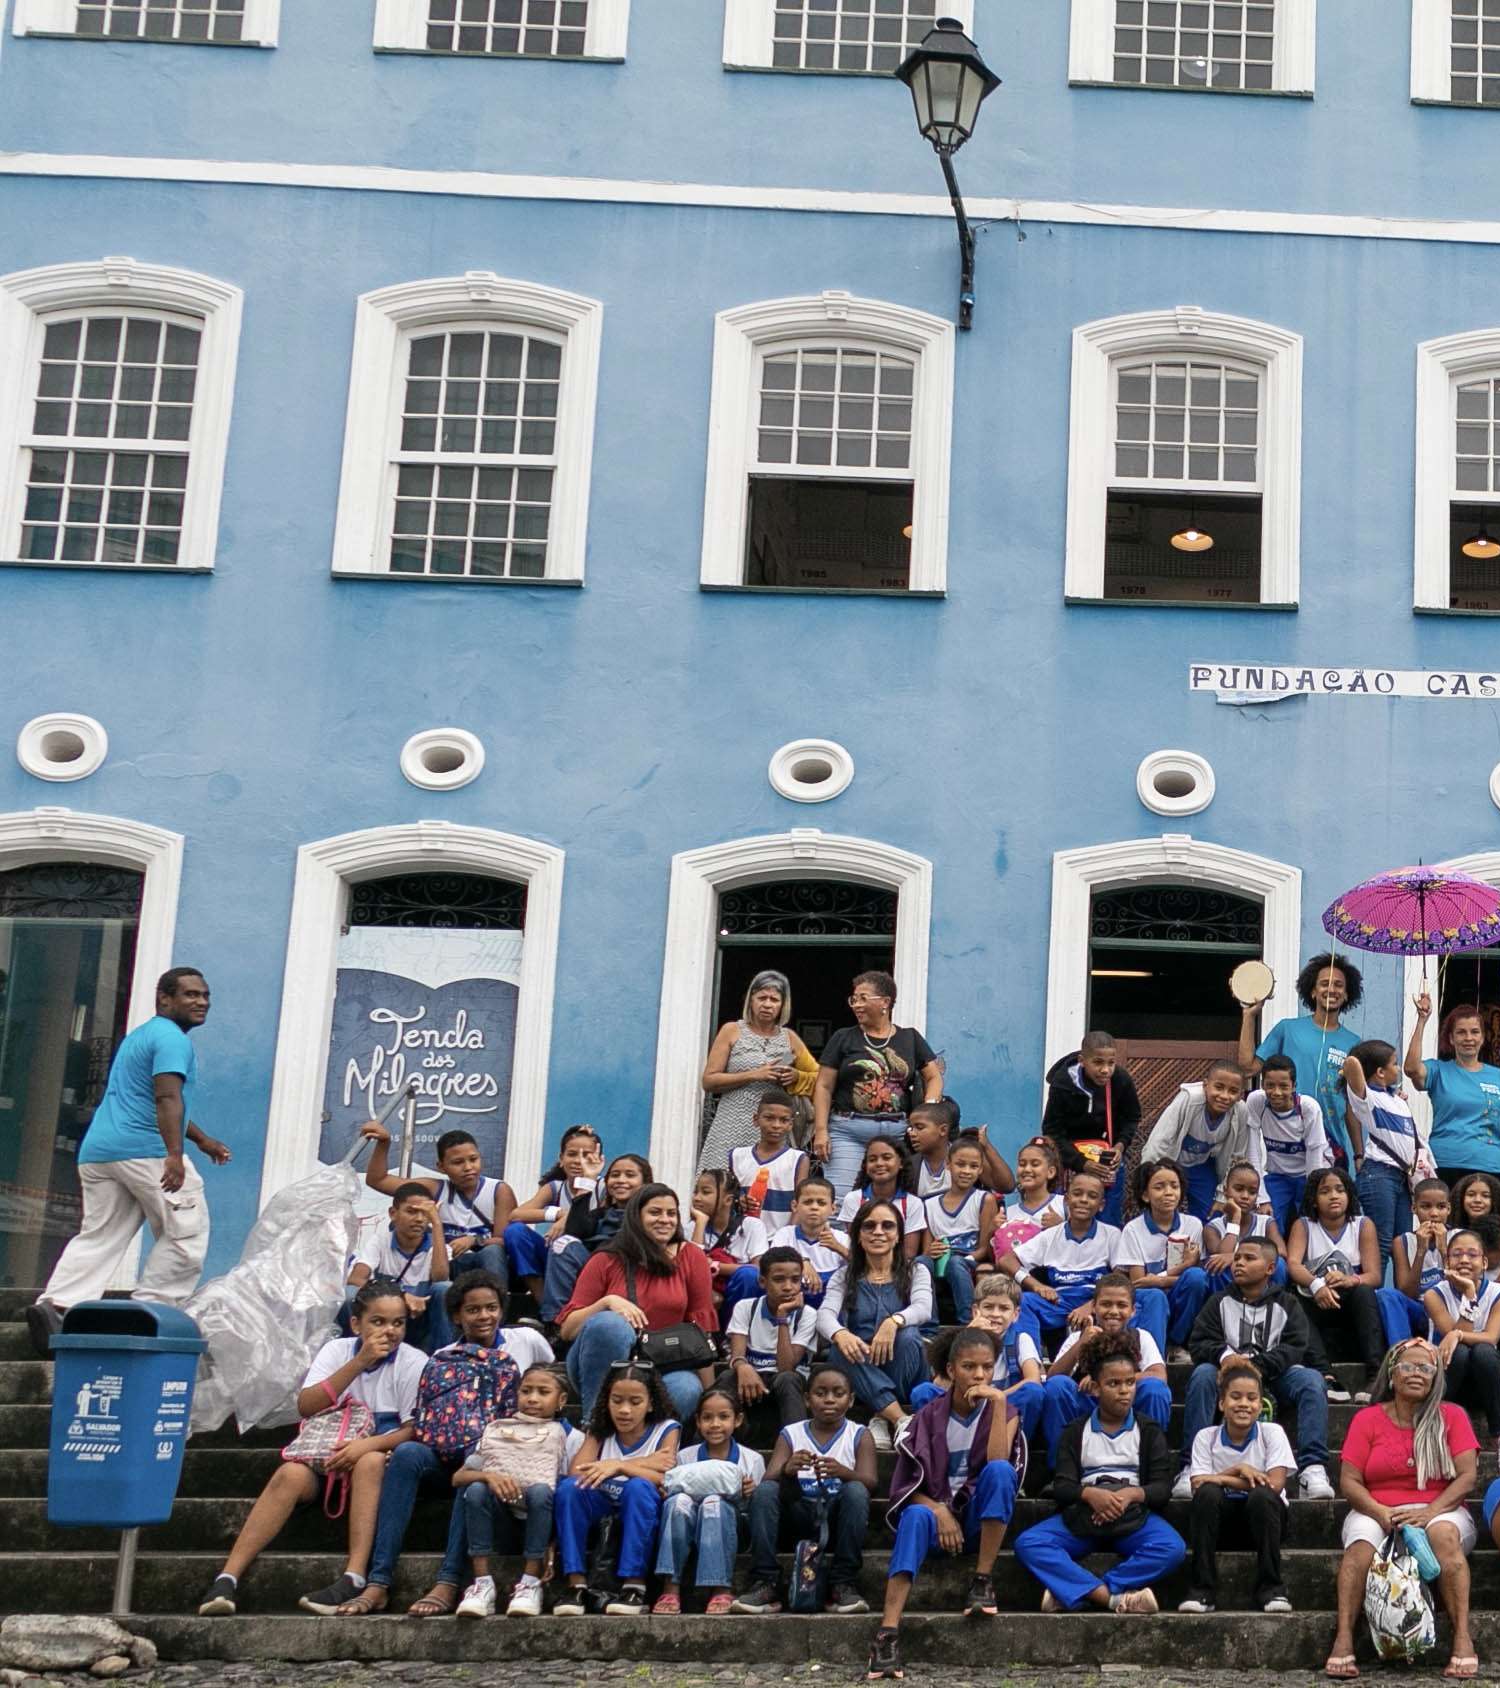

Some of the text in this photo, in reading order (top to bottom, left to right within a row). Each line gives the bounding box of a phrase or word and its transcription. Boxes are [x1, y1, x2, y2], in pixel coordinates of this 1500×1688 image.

[1191, 666, 1396, 694] FUNDAÇÃO
[369, 1005, 485, 1056] Tenda
[421, 1051, 456, 1069] dos
[343, 1044, 499, 1125] Milagres
